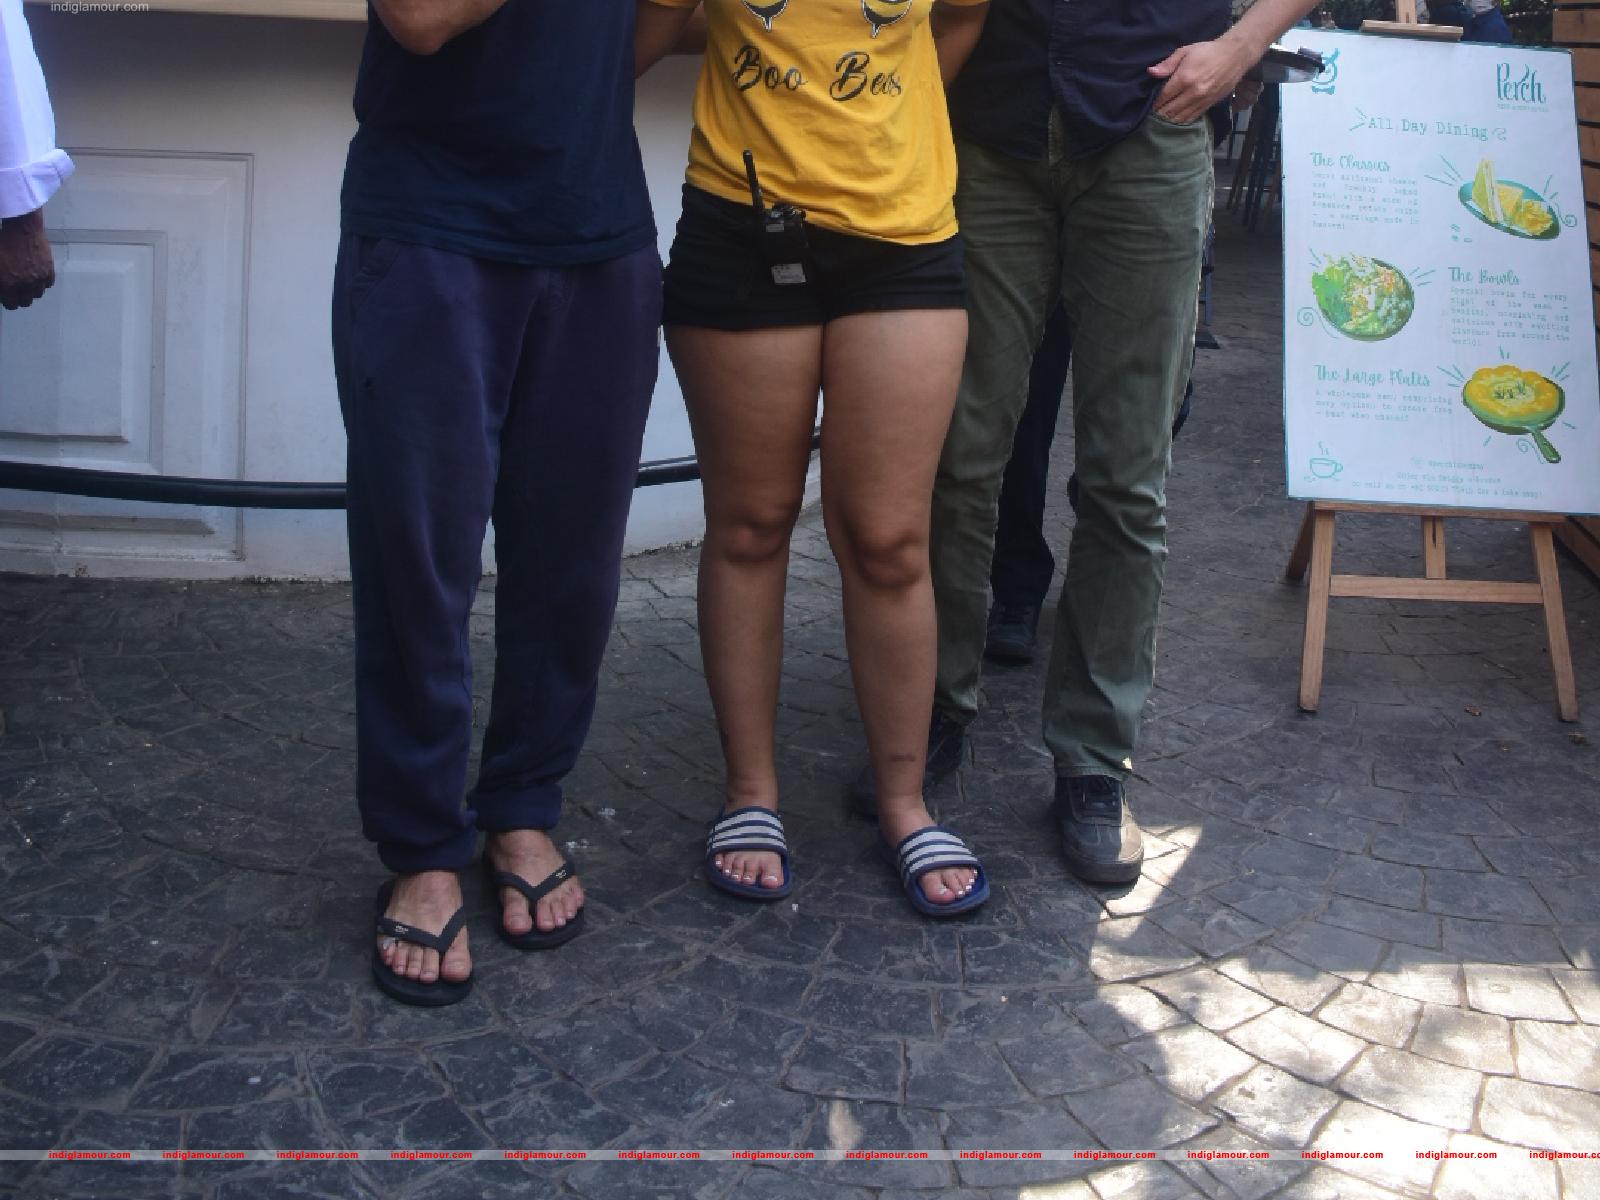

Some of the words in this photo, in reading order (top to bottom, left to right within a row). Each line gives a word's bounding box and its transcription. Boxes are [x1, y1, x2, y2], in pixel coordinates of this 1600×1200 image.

[732, 44, 808, 92] Boo
[1496, 63, 1547, 104] Perch
[1368, 117, 1393, 130] All
[1401, 118, 1428, 136] Day
[1436, 120, 1489, 142] Dining
[1309, 151, 1335, 167] The
[1447, 266, 1473, 283] The
[1313, 364, 1339, 381] The
[1343, 368, 1385, 387] Large
[1389, 368, 1431, 387] Plates
